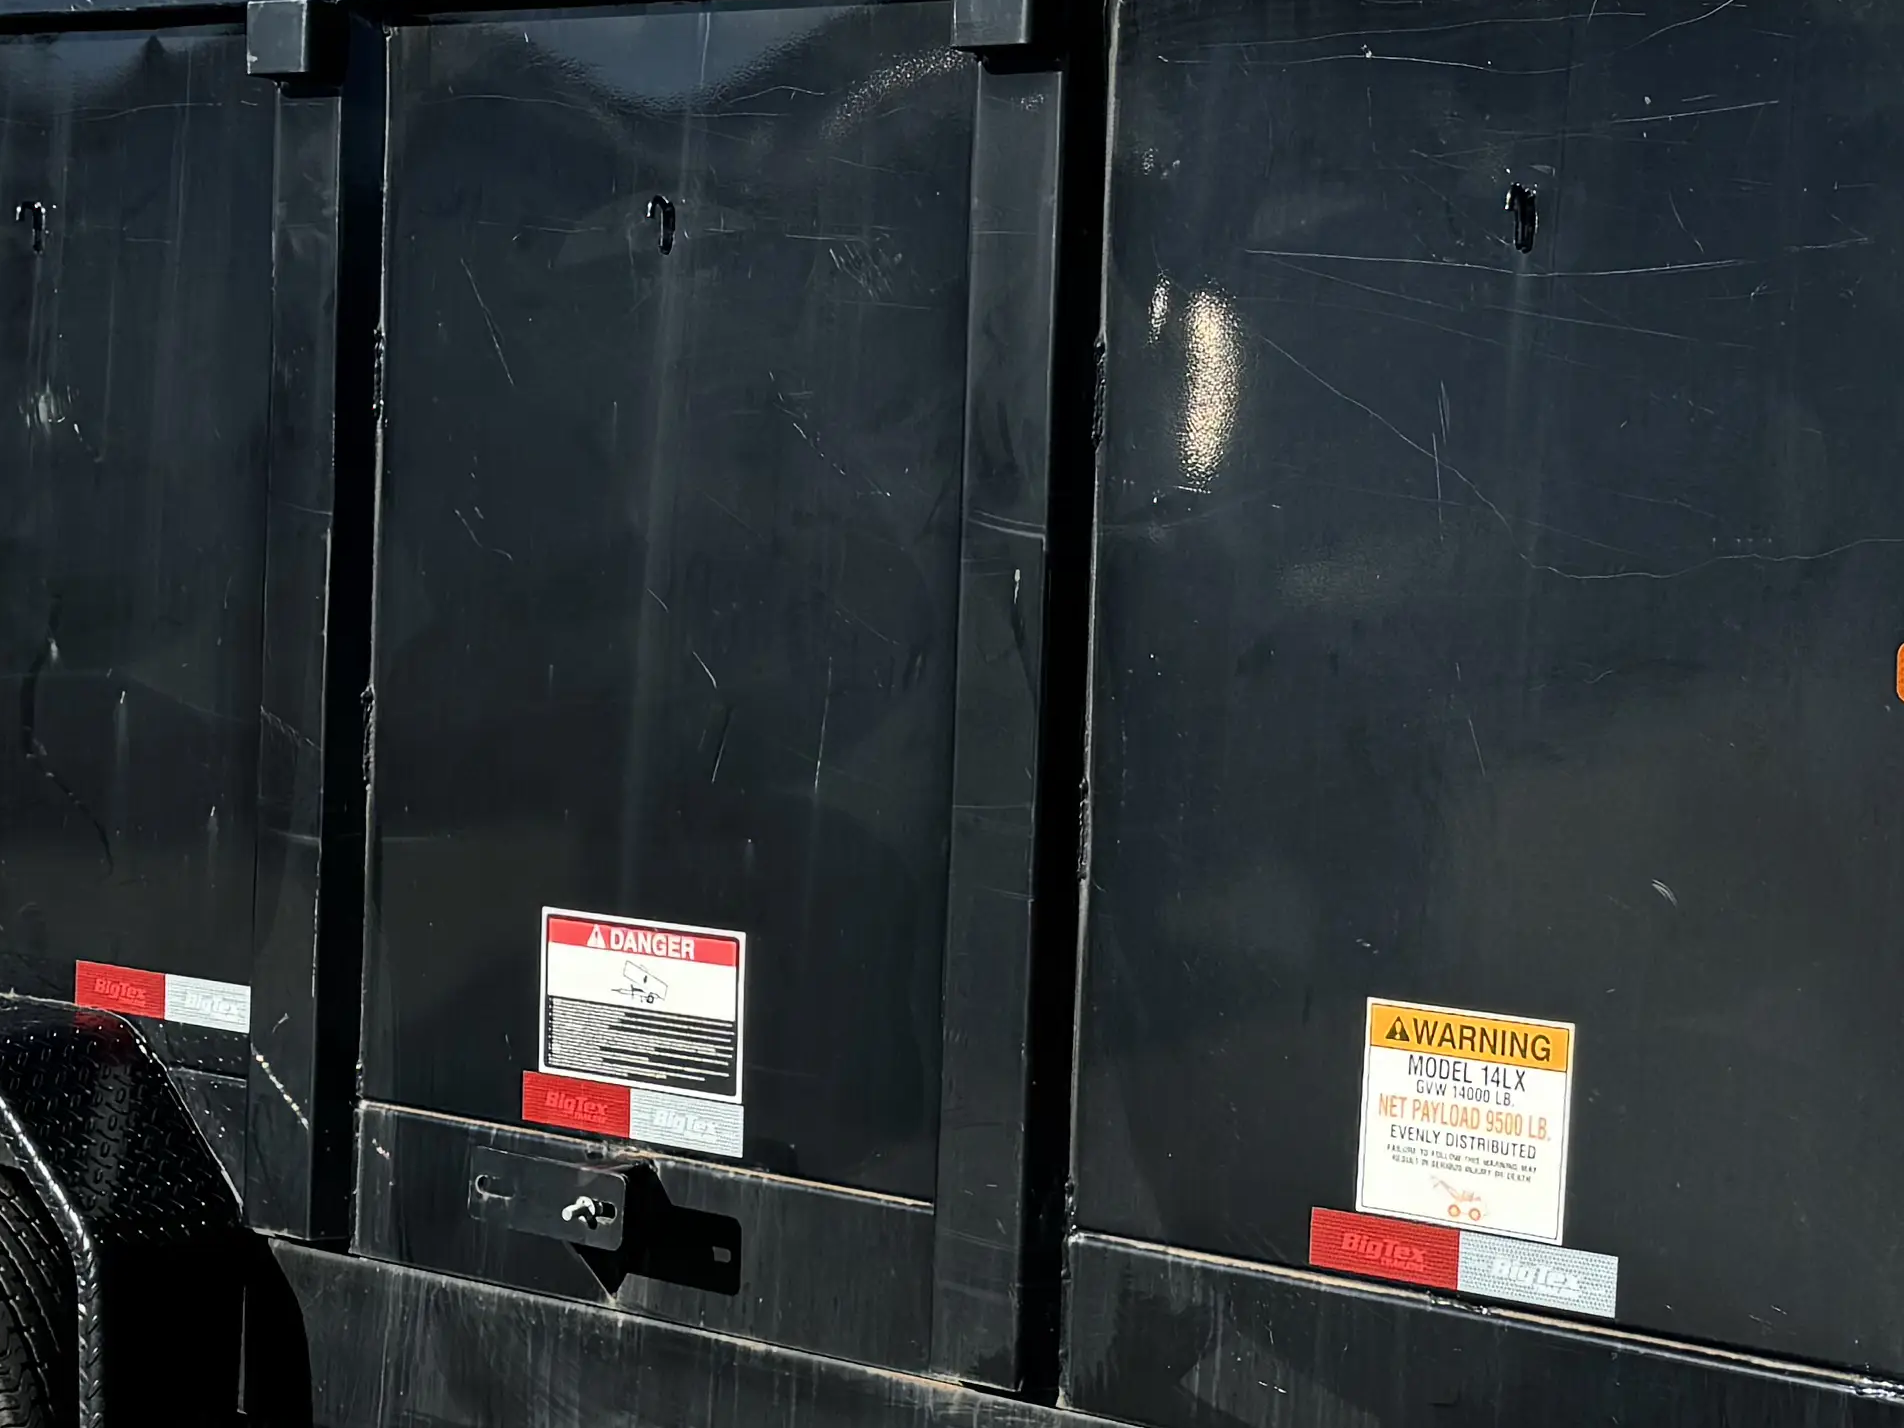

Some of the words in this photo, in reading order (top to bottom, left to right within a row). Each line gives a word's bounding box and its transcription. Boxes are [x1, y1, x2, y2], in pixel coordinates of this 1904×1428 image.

[610, 927, 696, 960] DANGER
[1412, 1017, 1552, 1062] WARNING
[1408, 1053, 1474, 1084] MODEL
[1481, 1065, 1526, 1092] 14LX
[1416, 1079, 1447, 1096] GVW
[1453, 1085, 1490, 1103] 14000
[1496, 1091, 1515, 1107] LB.
[1378, 1093, 1408, 1118] NET
[1412, 1098, 1480, 1130] PAYLOAD
[1486, 1110, 1523, 1136] 9500
[1528, 1115, 1552, 1142] LB.
[1390, 1124, 1441, 1144] EVENLY
[1446, 1132, 1537, 1160] DISTRIBUTED
[1341, 1232, 1427, 1263] BigTex
